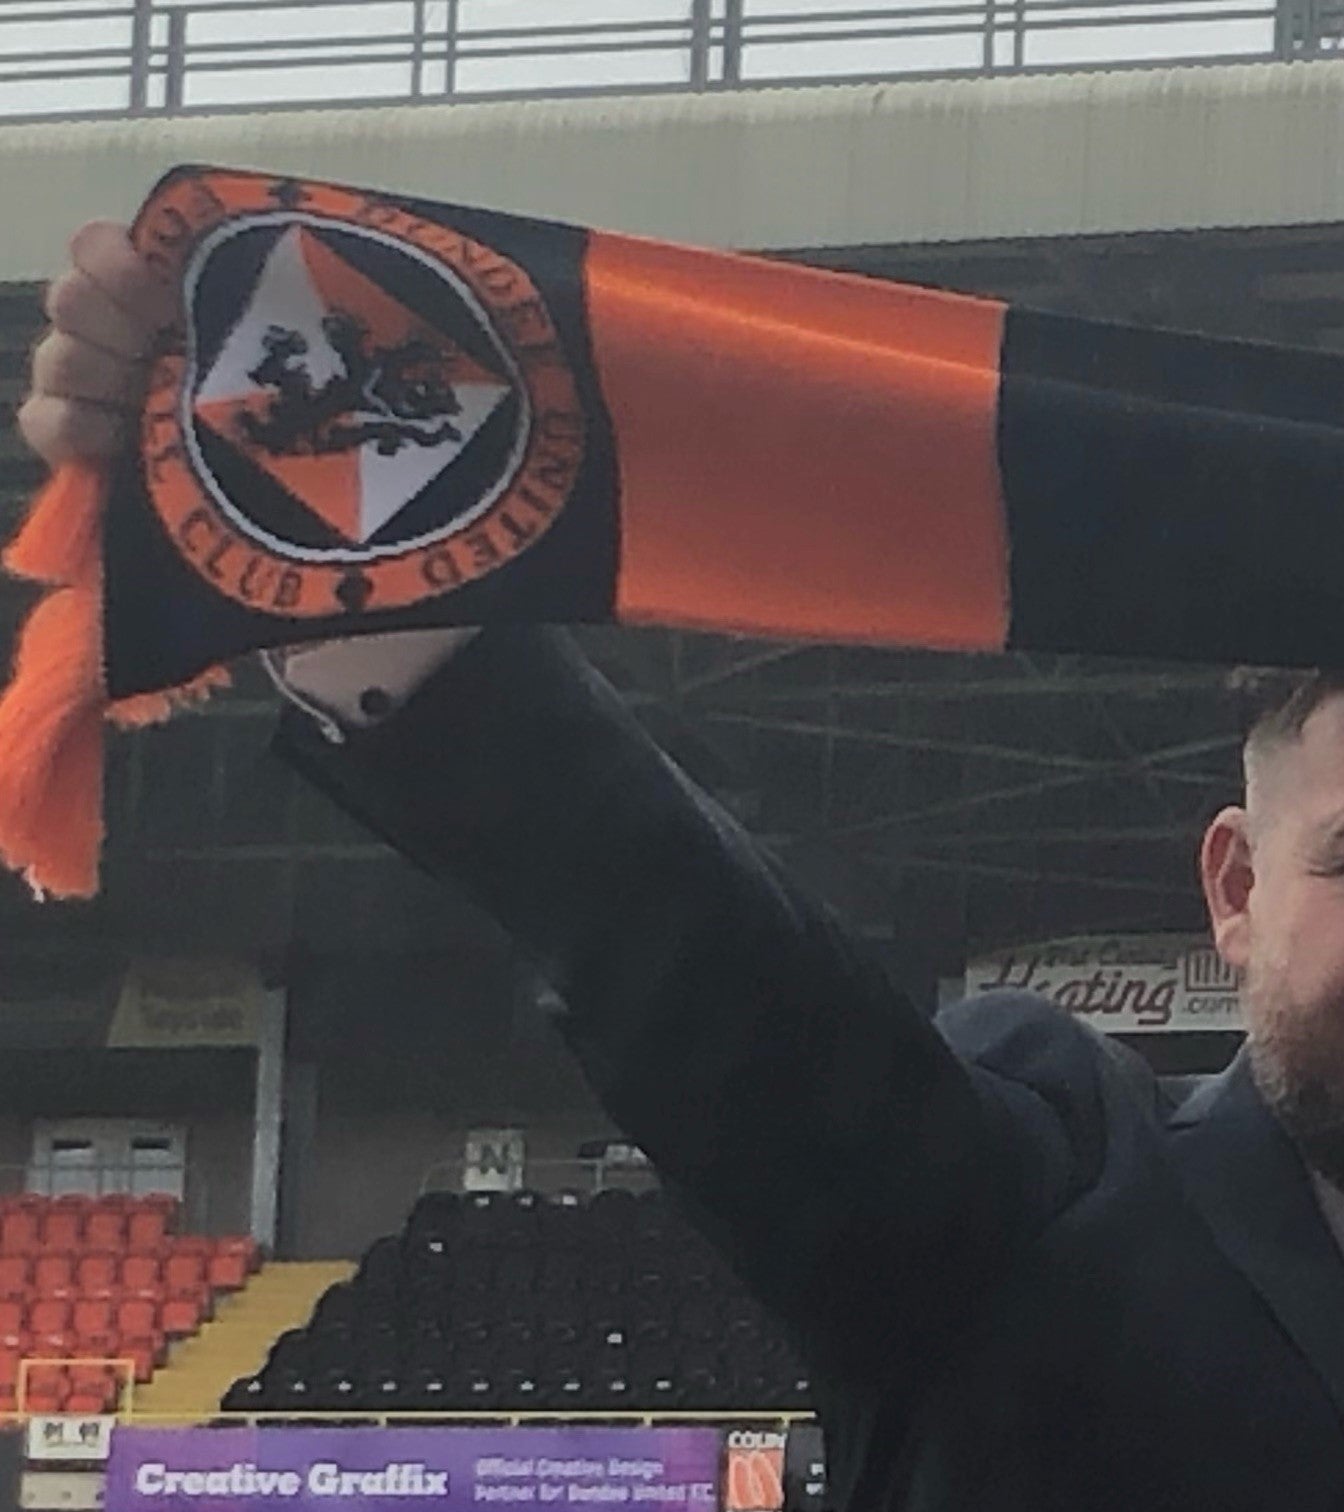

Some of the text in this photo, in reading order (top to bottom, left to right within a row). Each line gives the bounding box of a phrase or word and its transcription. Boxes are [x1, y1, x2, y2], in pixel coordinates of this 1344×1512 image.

[180, 508, 302, 608] CLUB
[978, 950, 1179, 1026] Hating
[479, 1143, 508, 1175] N
[136, 1463, 450, 1496] Creative Graffix
